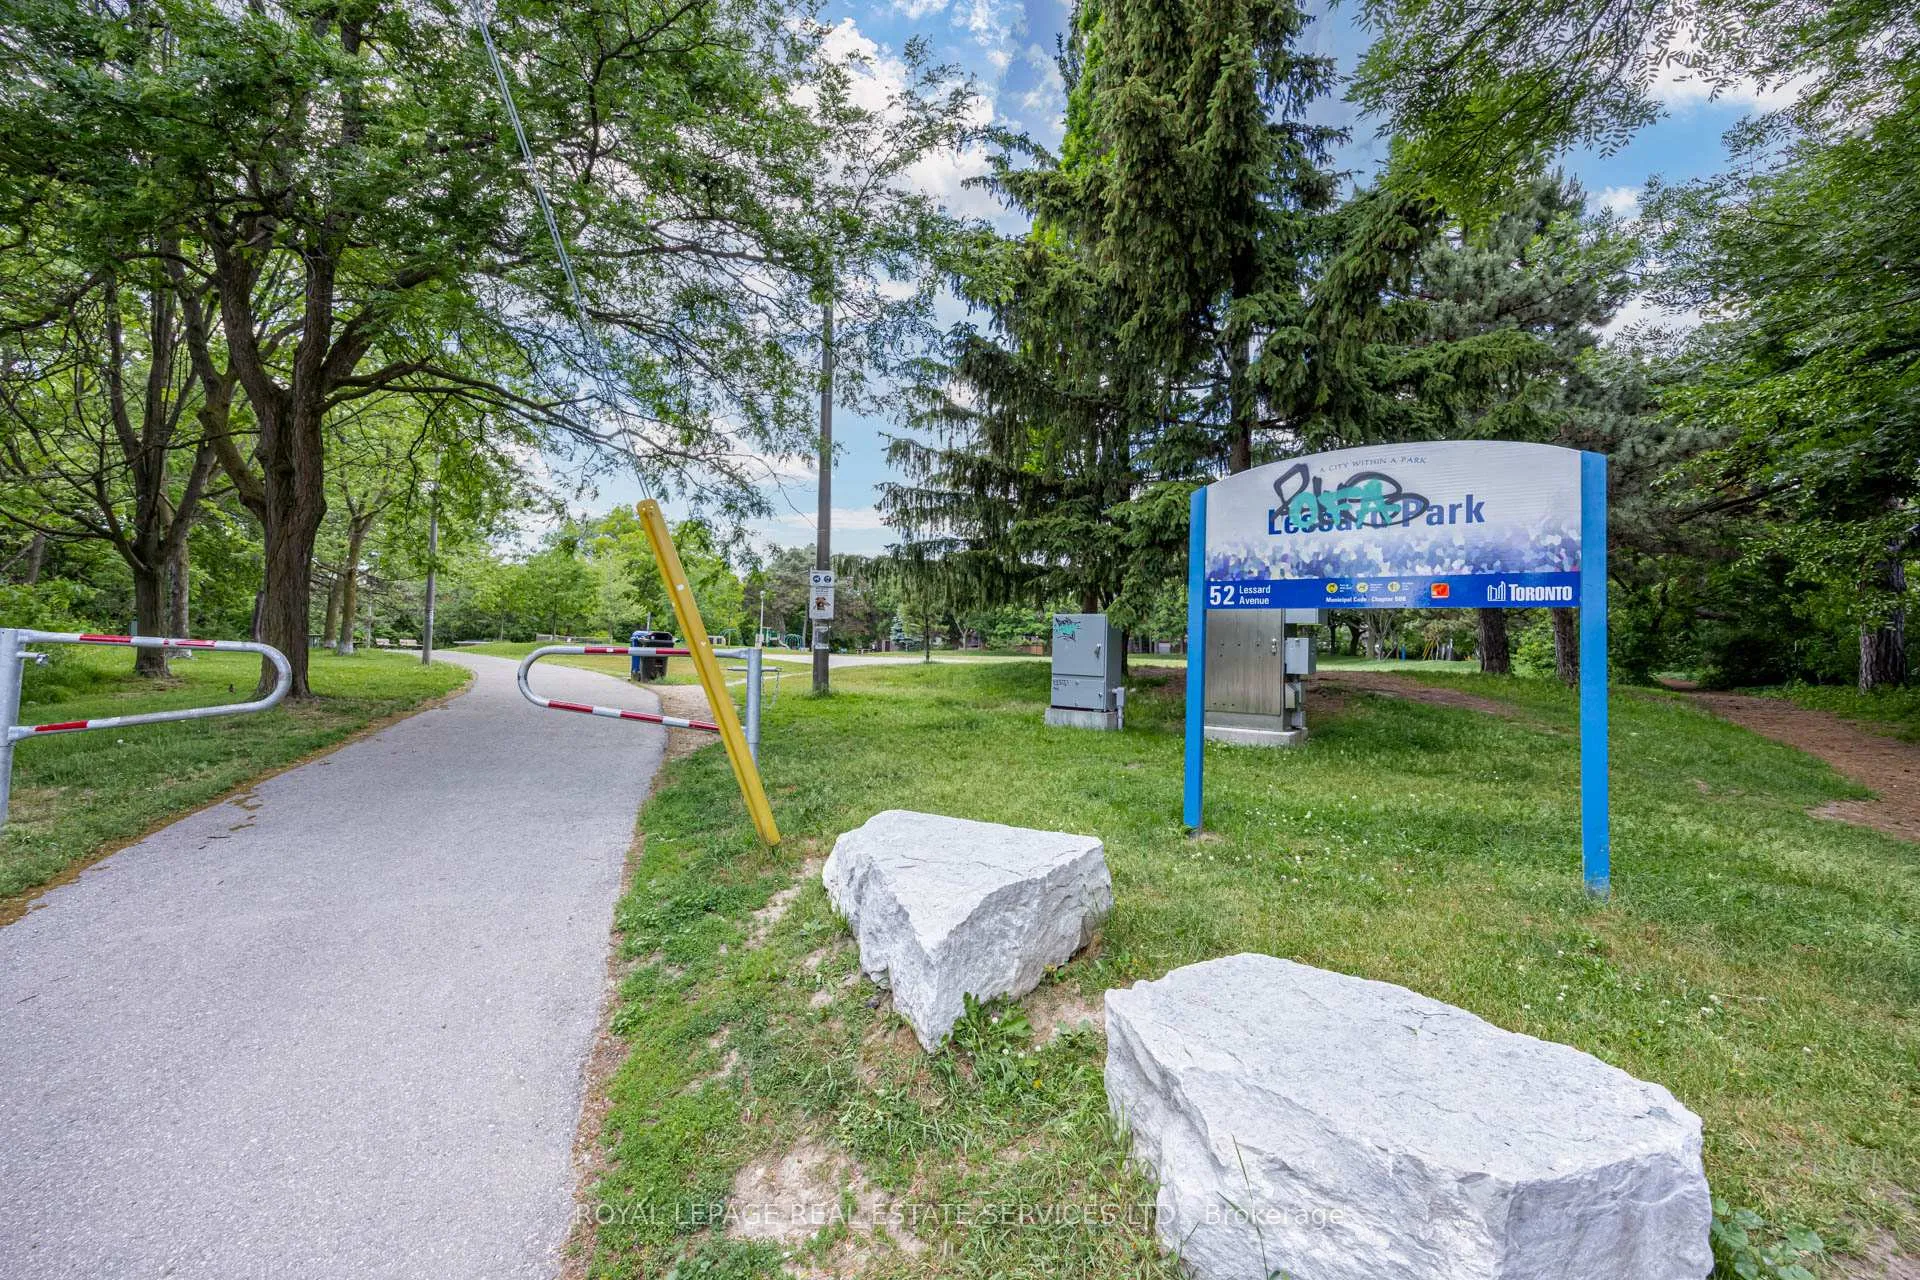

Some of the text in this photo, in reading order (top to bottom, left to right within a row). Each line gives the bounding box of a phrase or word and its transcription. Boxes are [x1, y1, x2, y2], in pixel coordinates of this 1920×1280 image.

[1329, 462, 1350, 473] CITY
[1352, 457, 1388, 467] WITHIN
[1400, 455, 1429, 465] PARK
[1402, 494, 1486, 528] Park
[1209, 585, 1235, 606] 52
[1239, 584, 1271, 594] Lessard
[1508, 583, 1573, 602] TORONTO
[1239, 595, 1270, 605] Avenue
[1325, 596, 1353, 604] Municipal
